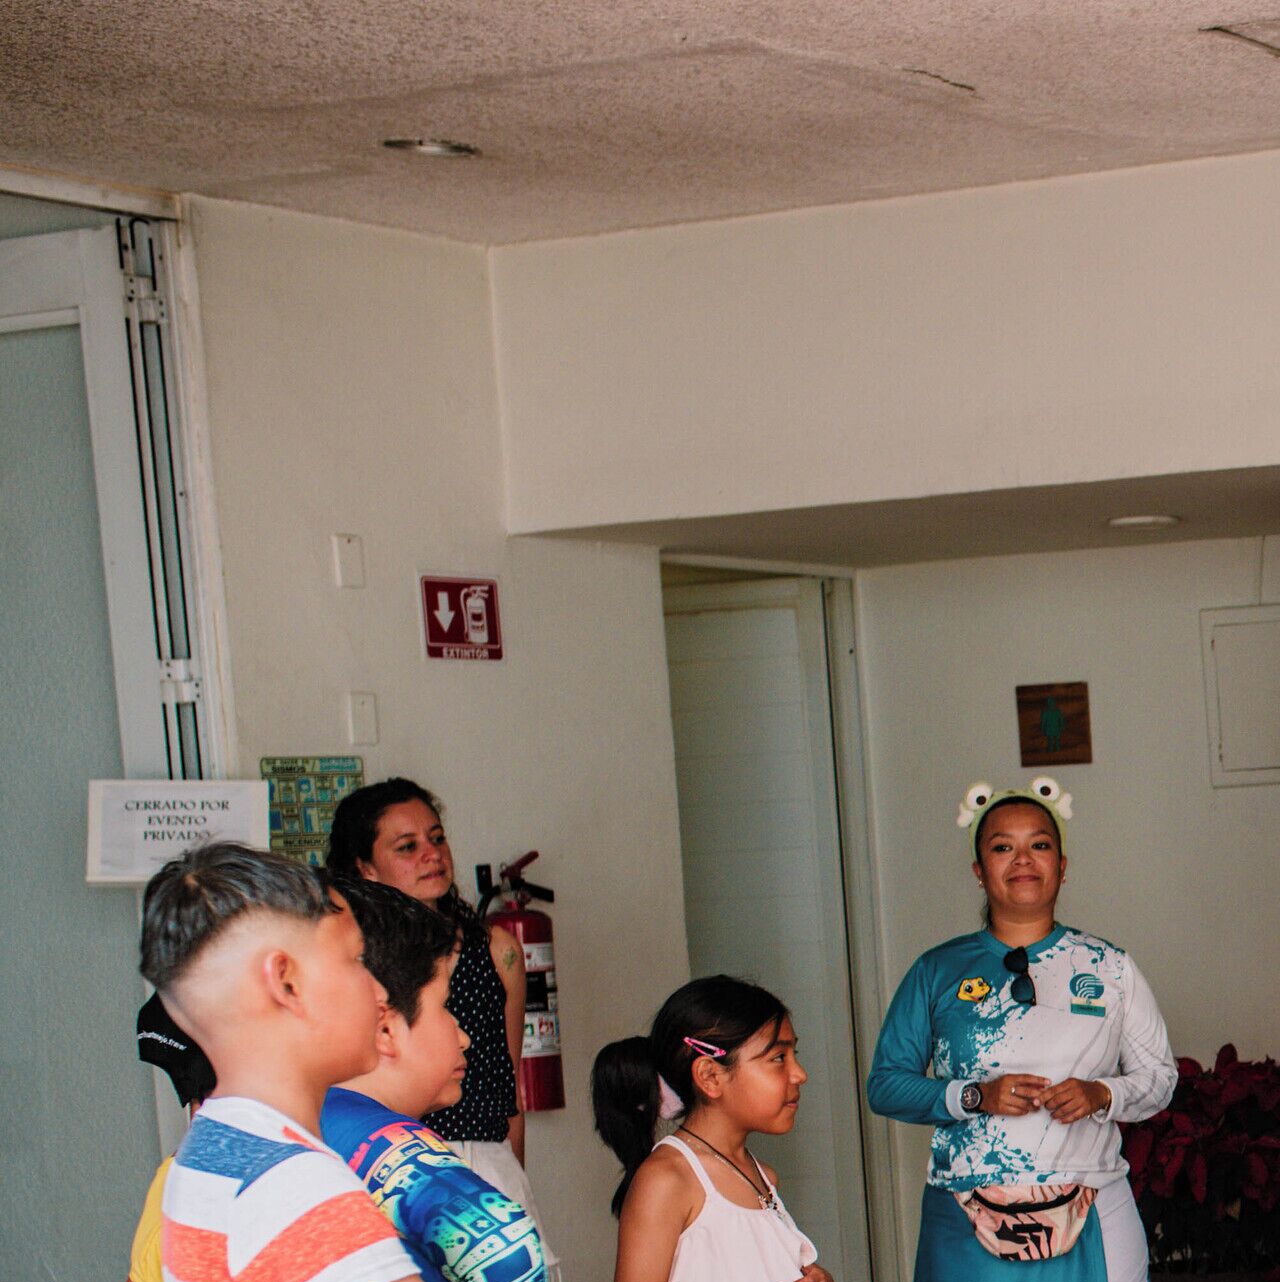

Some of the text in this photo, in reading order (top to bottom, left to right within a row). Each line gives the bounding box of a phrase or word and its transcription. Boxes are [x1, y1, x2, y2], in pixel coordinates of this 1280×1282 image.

[443, 648, 490, 660] EXTINTOR
[124, 799, 230, 812] CERRADO POR
[147, 815, 207, 826] EVENTO
[143, 831, 210, 842] PRIVADO
